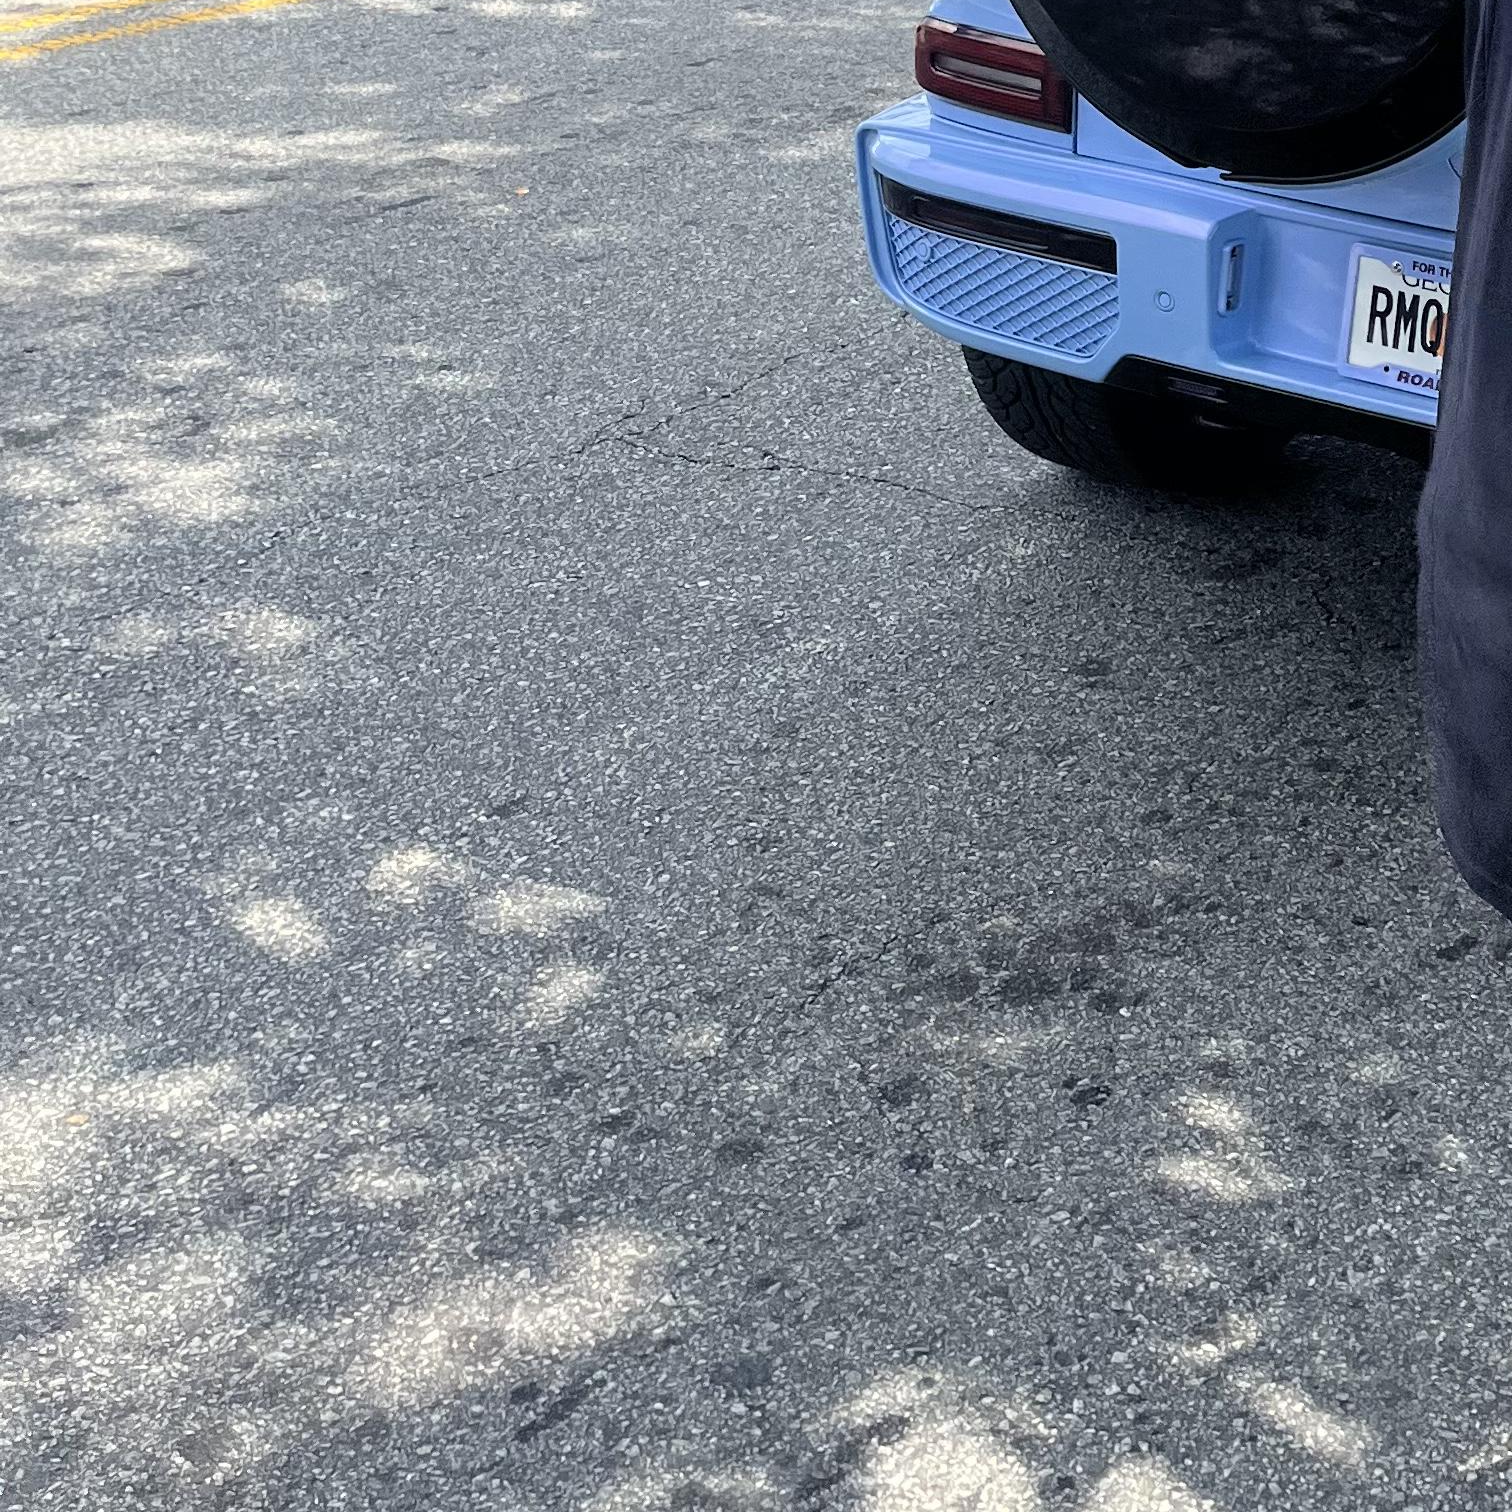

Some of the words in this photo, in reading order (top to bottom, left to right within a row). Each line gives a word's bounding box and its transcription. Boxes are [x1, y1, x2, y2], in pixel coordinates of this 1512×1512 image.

[1412, 260, 1436, 275] FOR
[1439, 266, 1452, 278] TH
[1367, 284, 1444, 357] RMQ
[1397, 370, 1440, 391] ROA
